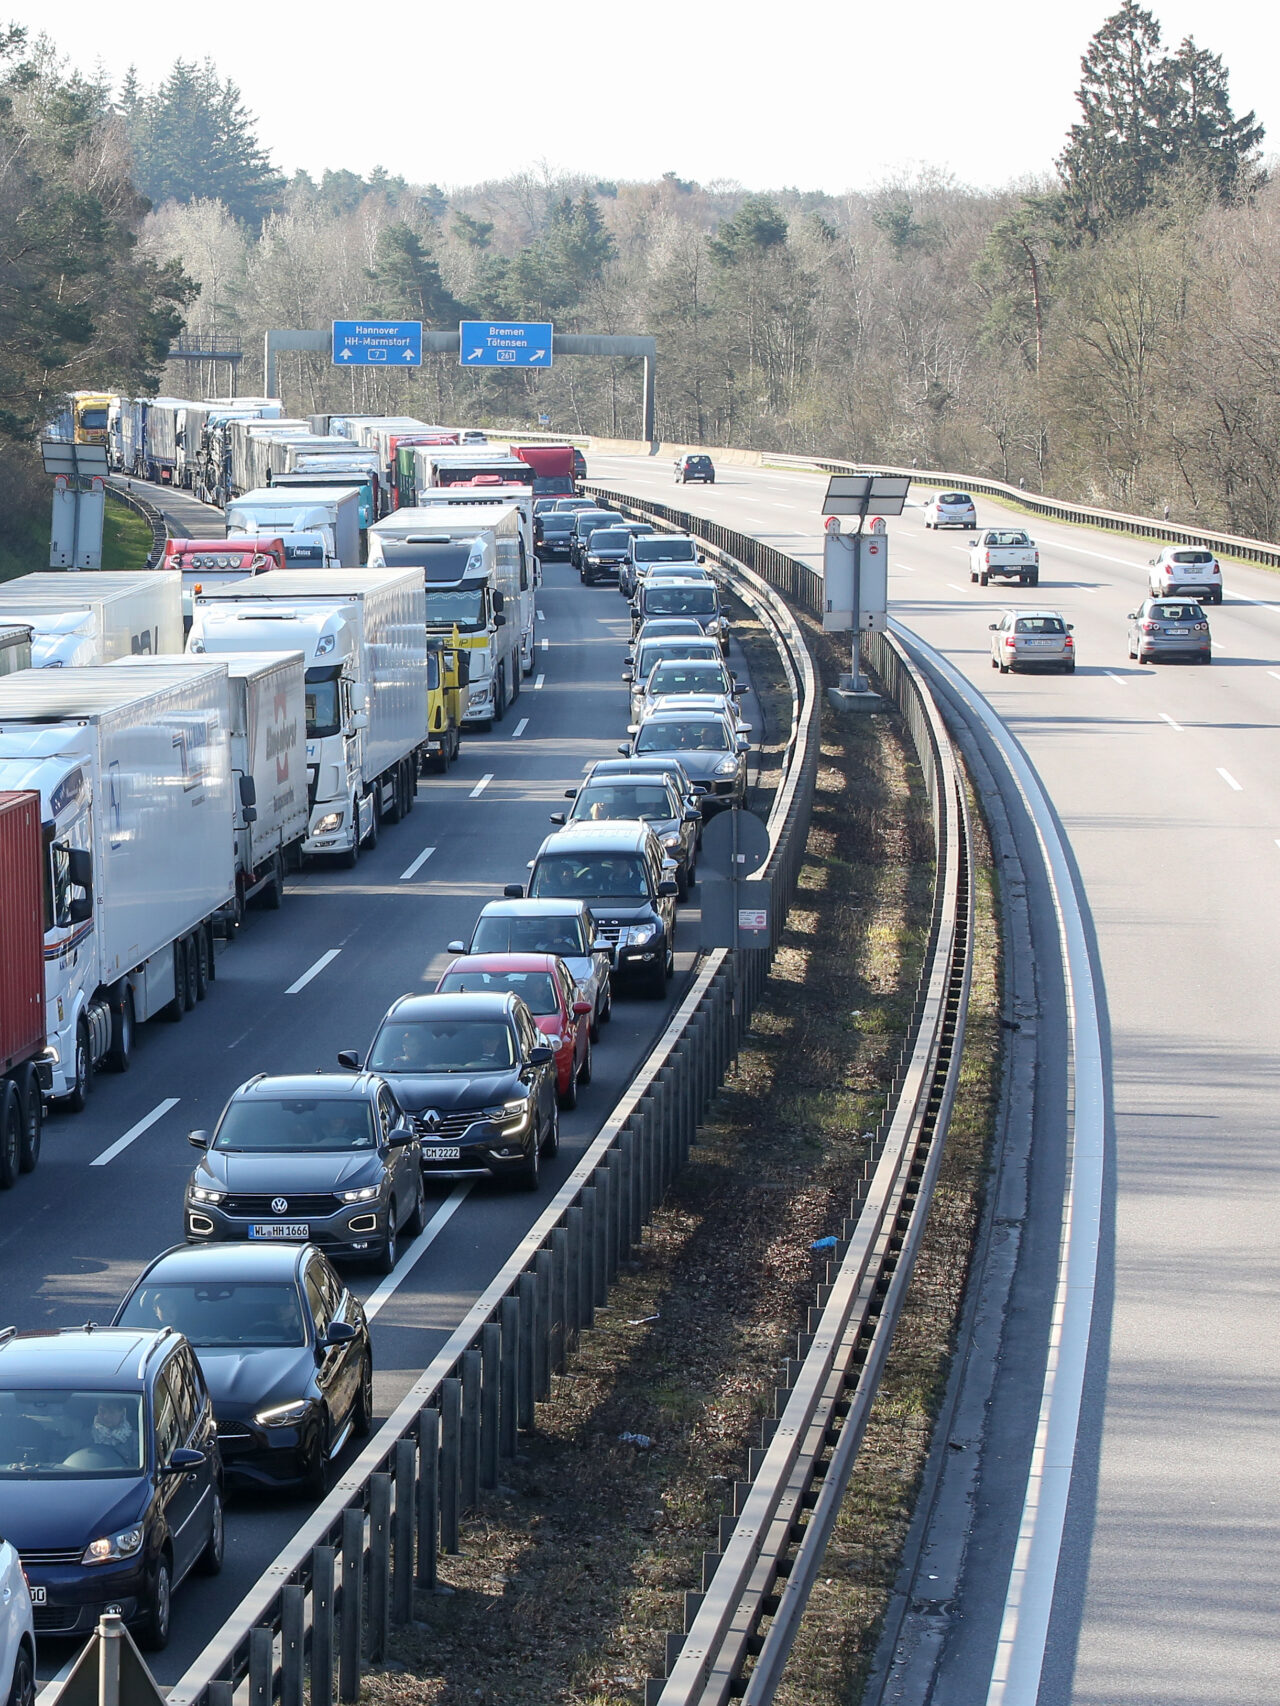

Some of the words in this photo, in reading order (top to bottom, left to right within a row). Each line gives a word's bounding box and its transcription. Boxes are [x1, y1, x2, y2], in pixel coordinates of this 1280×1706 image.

[355, 326, 399, 335] Hannover
[489, 327, 524, 336] Bremen
[344, 337, 410, 346] HH-Marmstorf
[486, 337, 527, 347] Tötensen
[374, 351, 380, 359] 7
[500, 352, 513, 360] 261
[439, 1149, 459, 1157] 2222
[255, 1227, 265, 1236] WL
[273, 1227, 284, 1236] HH
[286, 1226, 307, 1235] 1666
